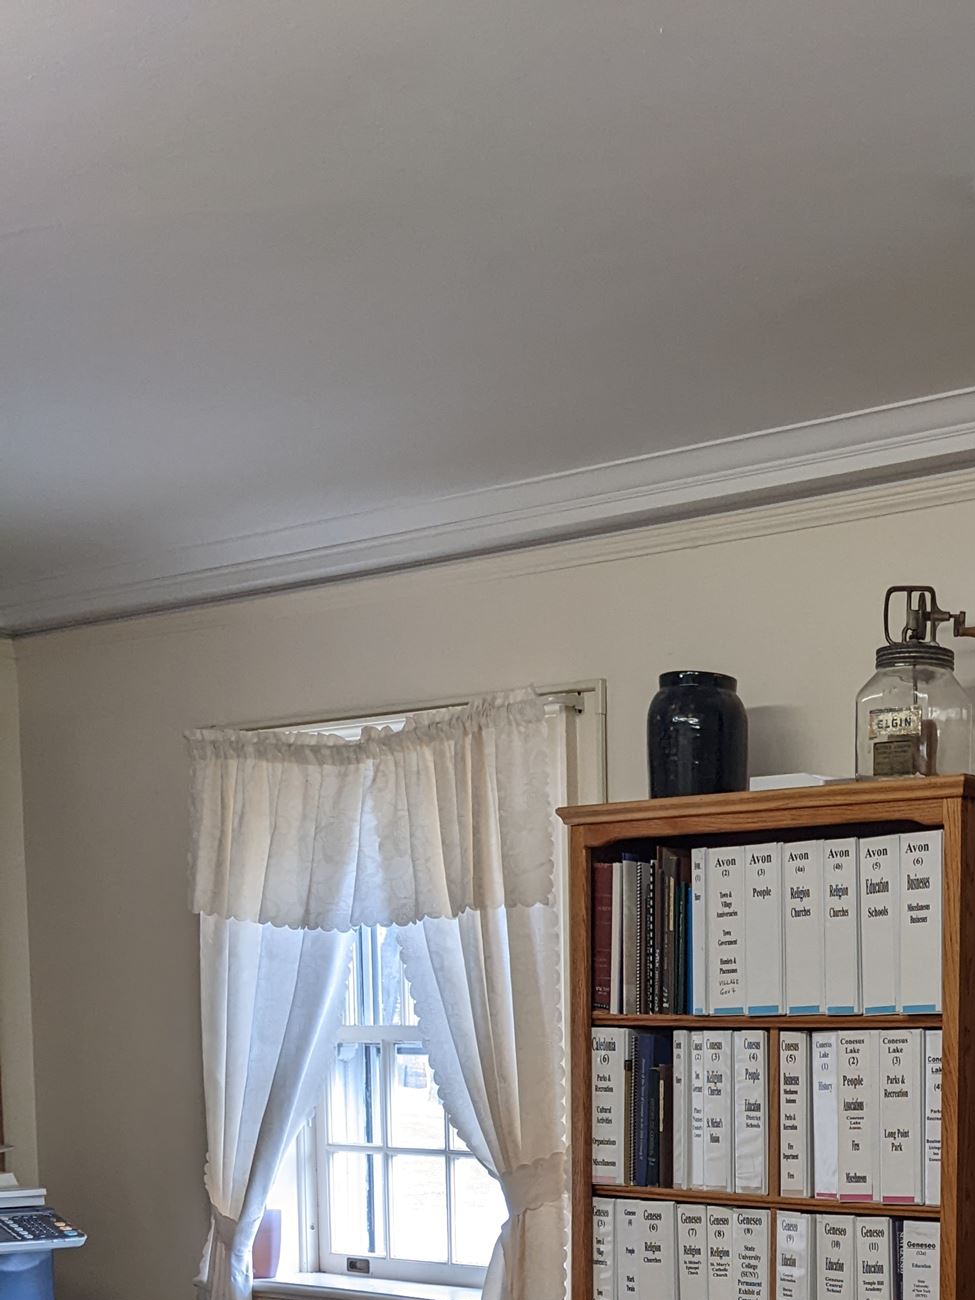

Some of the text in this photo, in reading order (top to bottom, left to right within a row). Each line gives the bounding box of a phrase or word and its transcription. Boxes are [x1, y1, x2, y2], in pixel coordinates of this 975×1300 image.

[878, 717, 911, 729] ELGIN
[865, 848, 888, 858] Avon
[905, 843, 929, 853] Avon
[788, 852, 809, 862] Avon
[828, 849, 849, 859] Avon
[715, 858, 736, 868] Avon
[750, 854, 771, 865] Avon
[913, 857, 923, 866] (6)
[872, 862, 881, 871] (5)
[866, 877, 889, 895] Education
[753, 887, 771, 899] People
[790, 887, 810, 902] Religion
[829, 884, 848, 900] Religion
[791, 907, 811, 918] Churches
[829, 907, 848, 918] Churches
[868, 906, 888, 918] Schools
[848, 1057, 858, 1066] (2)
[892, 1056, 900, 1066] (3)
[843, 1075, 863, 1089] People
[884, 1089, 908, 1098] Recreation
[884, 1129, 909, 1140] Long Point
[891, 1142, 902, 1151] Park
[681, 1213, 702, 1224] Geneseo
[737, 1213, 762, 1225] Geneseo
[825, 1223, 846, 1236] Geneseo
[861, 1226, 884, 1238] Geneseo
[907, 1241, 936, 1250] Geneseo
[738, 1253, 761, 1262] University
[741, 1262, 758, 1271] College
[738, 1279, 762, 1287] Permanent
